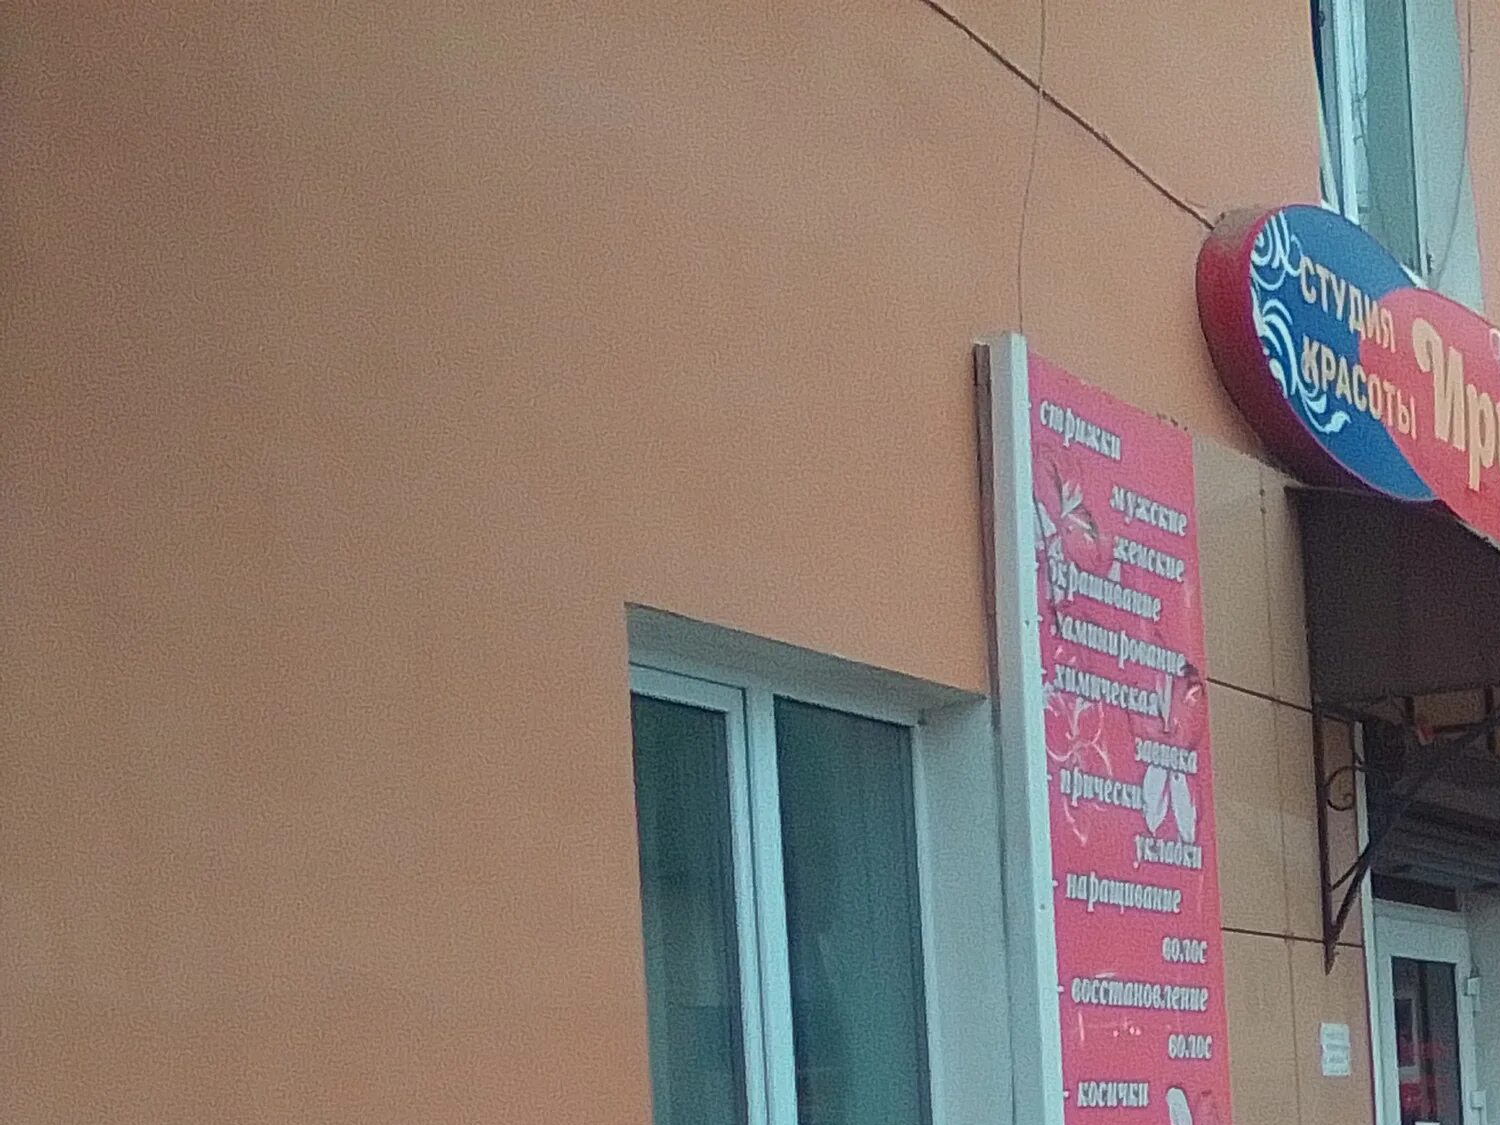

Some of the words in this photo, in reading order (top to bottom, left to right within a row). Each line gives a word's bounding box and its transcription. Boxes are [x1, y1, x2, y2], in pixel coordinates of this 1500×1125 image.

[1300, 255, 1396, 353] СТУДИЯ
[1301, 336, 1417, 440] КРАСОТЫ
[1039, 400, 1121, 461] стрижки
[1110, 486, 1188, 537] мужские
[1113, 536, 1185, 583] женские
[1065, 872, 1182, 914] наращивание
[1071, 977, 1208, 1011] восстановление
[1077, 1081, 1149, 1107] косички
